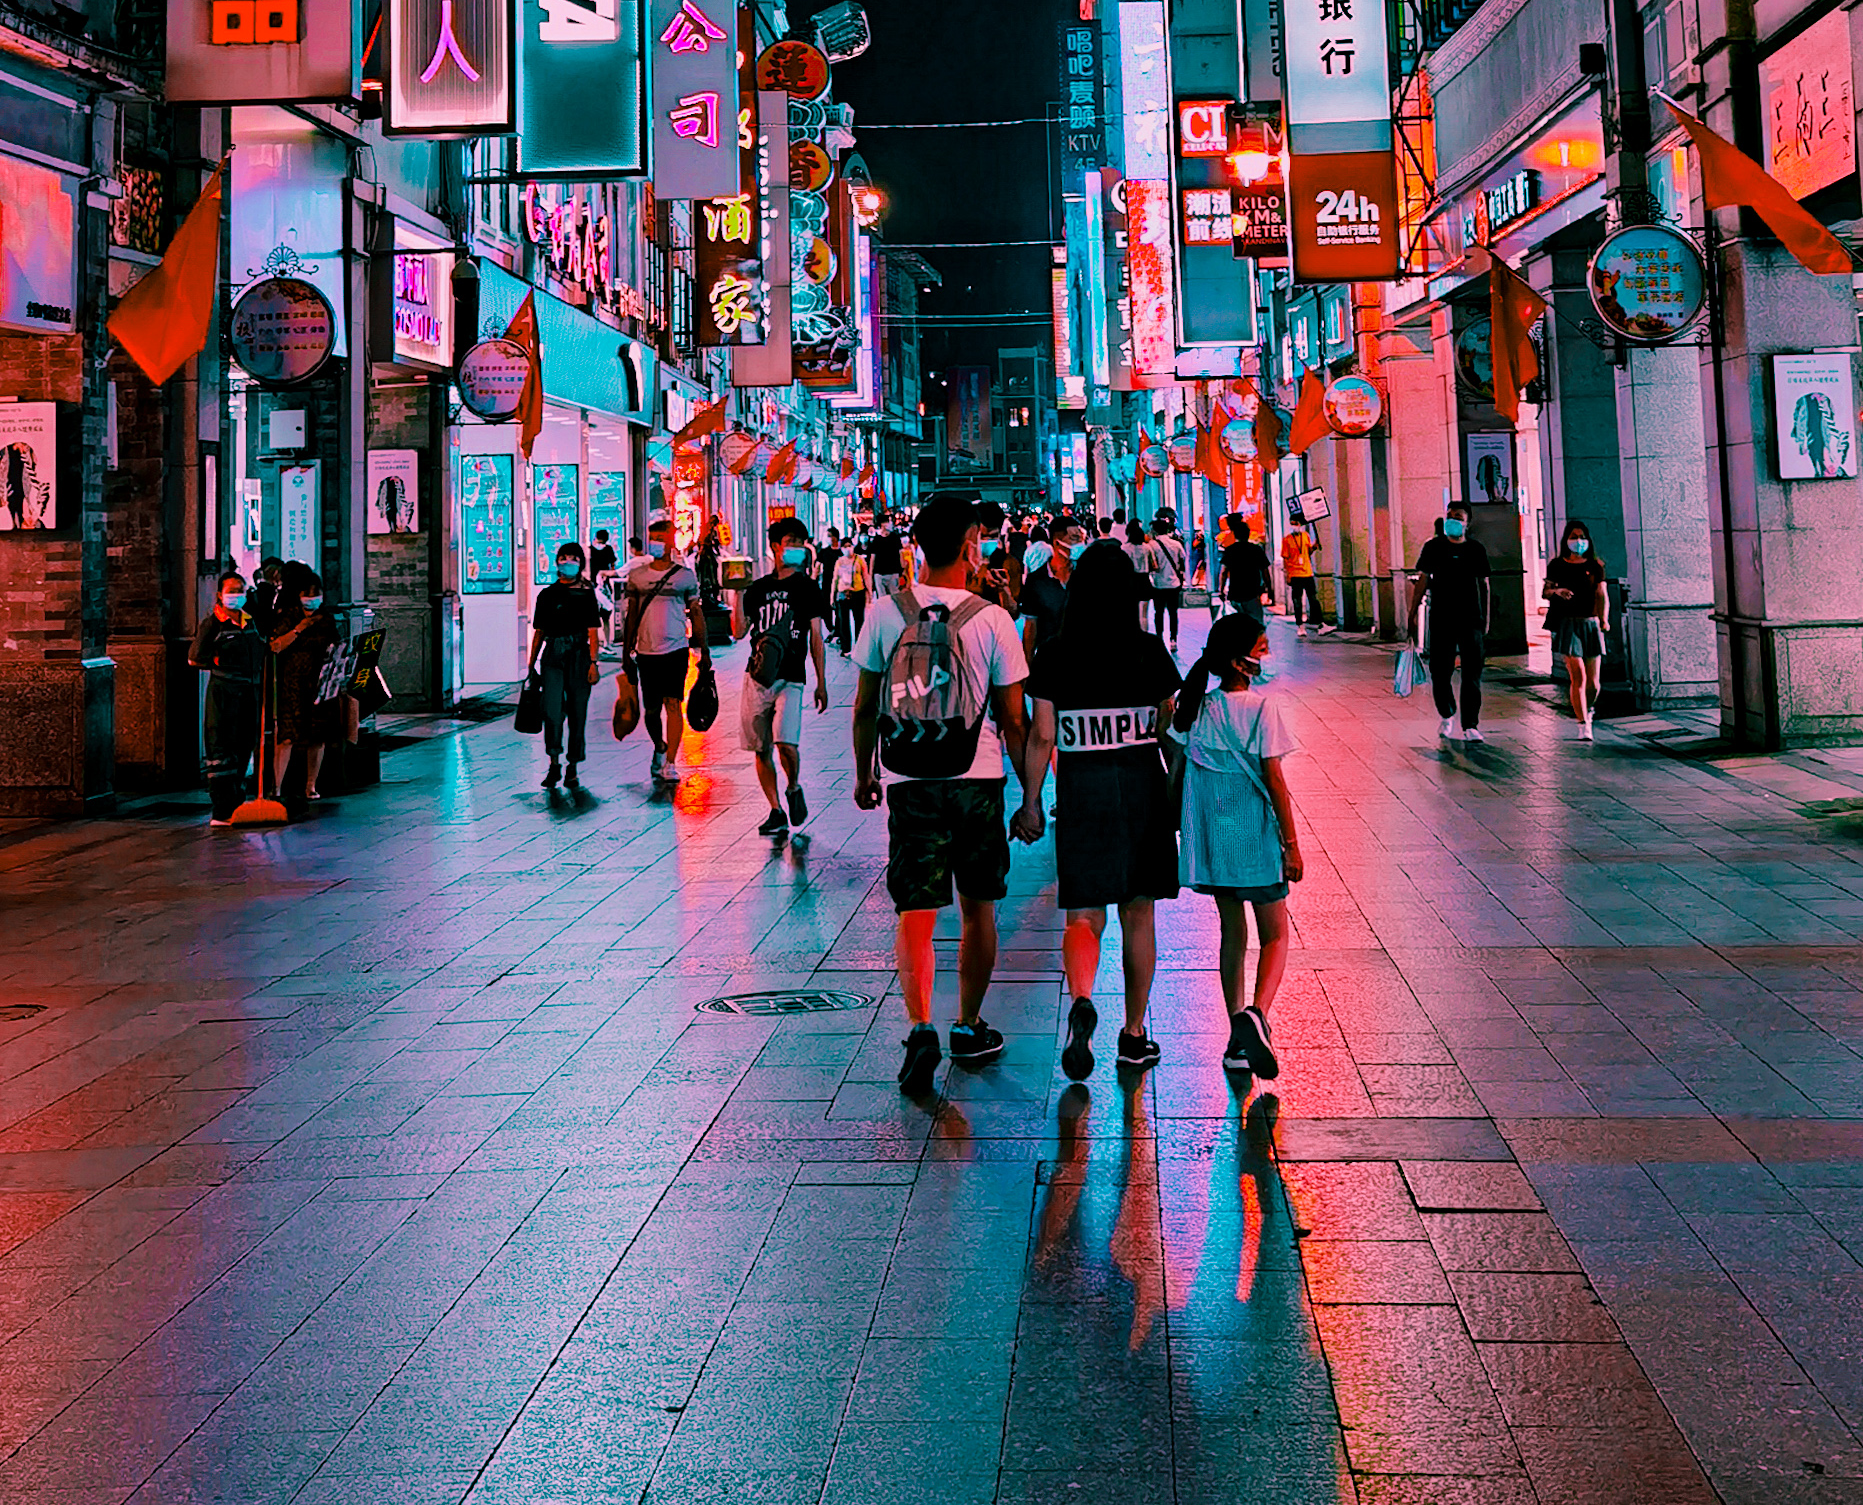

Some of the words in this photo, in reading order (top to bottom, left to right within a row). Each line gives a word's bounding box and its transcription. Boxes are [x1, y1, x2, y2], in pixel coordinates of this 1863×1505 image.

[1068, 134, 1101, 152] KTV
[1239, 195, 1280, 209] KILO
[1315, 189, 1380, 223] 24h
[891, 665, 950, 708] FILA
